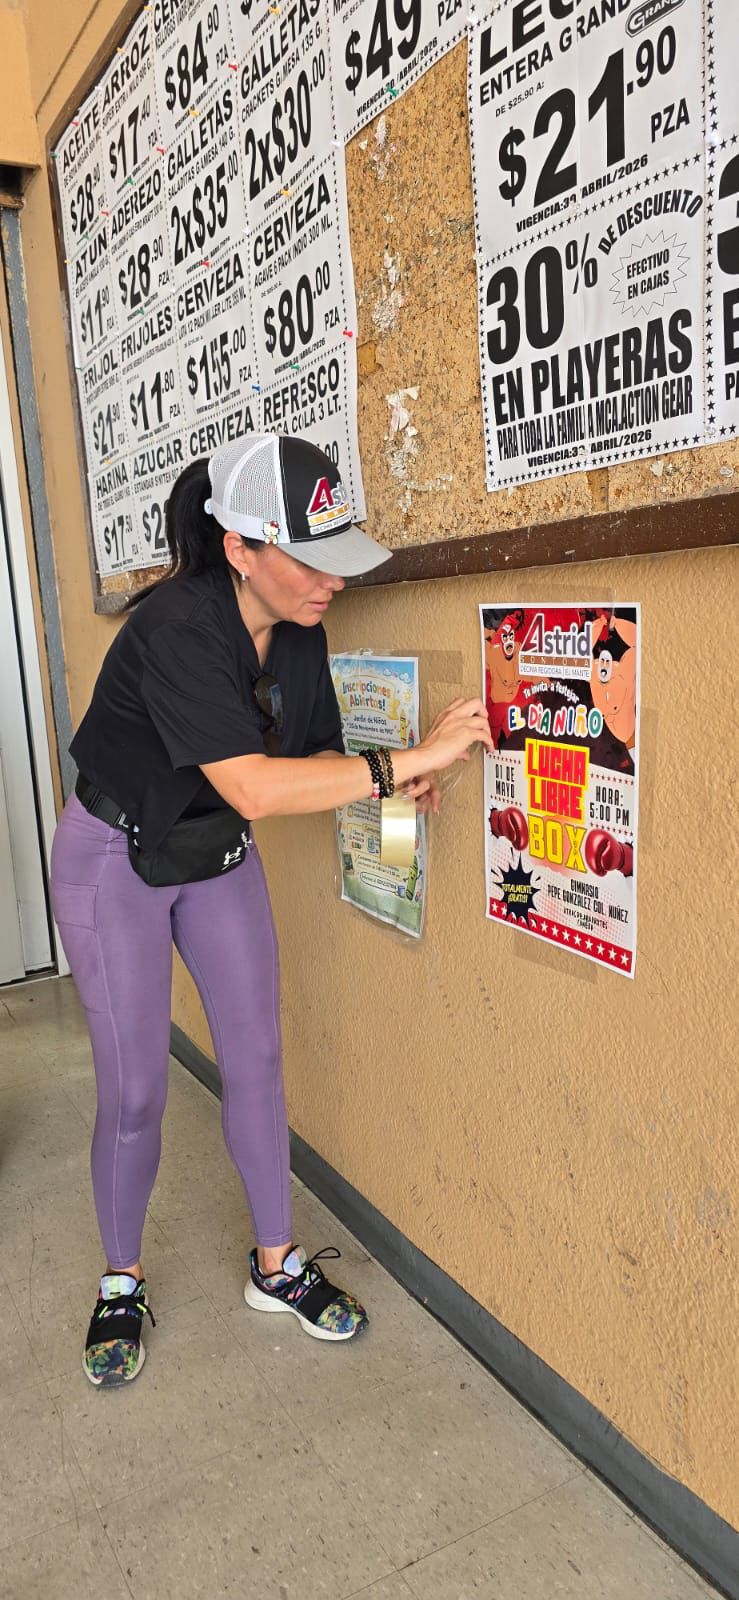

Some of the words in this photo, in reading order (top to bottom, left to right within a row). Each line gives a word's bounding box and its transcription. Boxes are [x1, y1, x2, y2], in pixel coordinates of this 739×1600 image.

[102, 24, 150, 113] ARROZ
[215, 44, 229, 70] PZA
[345, 0, 422, 96] $49
[241, 72, 274, 123] CRACKETS
[301, 29, 314, 56] 135
[480, 41, 554, 107] ENTERA
[495, 105, 506, 118] DE
[508, 86, 534, 111] $25.90
[536, 80, 545, 93] A:
[499, 25, 676, 208] $21.90
[651, 98, 690, 144] PZA
[63, 103, 100, 173] ACEITE
[167, 89, 233, 180] GALLETAS
[111, 169, 161, 240] ADEREZO
[253, 174, 331, 267] CERVEZA
[598, 224, 618, 256] DE
[616, 189, 704, 236] DESCUENTO
[75, 226, 107, 284] ATUN
[255, 262, 273, 287] AGAVE
[278, 249, 292, 273] PACK
[309, 222, 319, 244] 300
[626, 248, 670, 280] EFECTIVO
[158, 270, 170, 288] PZA
[177, 253, 244, 321] CERVEZA
[486, 232, 598, 364] 30%
[628, 282, 639, 300] EN
[641, 270, 670, 295] CAJAS
[264, 260, 330, 358] $80.00
[324, 306, 340, 331] PZA
[121, 305, 172, 362] FRIJOLES
[84, 349, 118, 394] FRIJOL
[239, 364, 252, 383] PZA
[492, 366, 525, 426] EN
[531, 308, 693, 415] PLAYERAS
[170, 403, 180, 418] PZA
[264, 358, 340, 426] REFRESCO
[318, 402, 324, 421] 3
[327, 393, 341, 416] LT.
[189, 406, 255, 456] CERVEZA
[496, 428, 518, 461] PARA
[518, 420, 543, 456] TODA
[543, 415, 556, 449] LA
[557, 401, 595, 447] FAMILA
[661, 374, 693, 420] GEAR
[96, 462, 128, 499] HARINA
[133, 438, 184, 479] AZUCAR
[521, 614, 591, 656] Astrid
[343, 681, 391, 699] Inscripciones
[508, 705, 526, 731] EL
[553, 704, 604, 738] NIÑO
[506, 767, 515, 782] DE
[527, 742, 587, 786] LUCHA
[495, 780, 515, 799] MAYO
[530, 777, 583, 820] LIBRE
[596, 785, 624, 807] HORA:
[589, 803, 612, 822] 5:00
[616, 810, 630, 827] PM
[528, 814, 587, 874] BOX
[547, 884, 561, 901] PEPE
[570, 879, 599, 900] GIMNASIO
